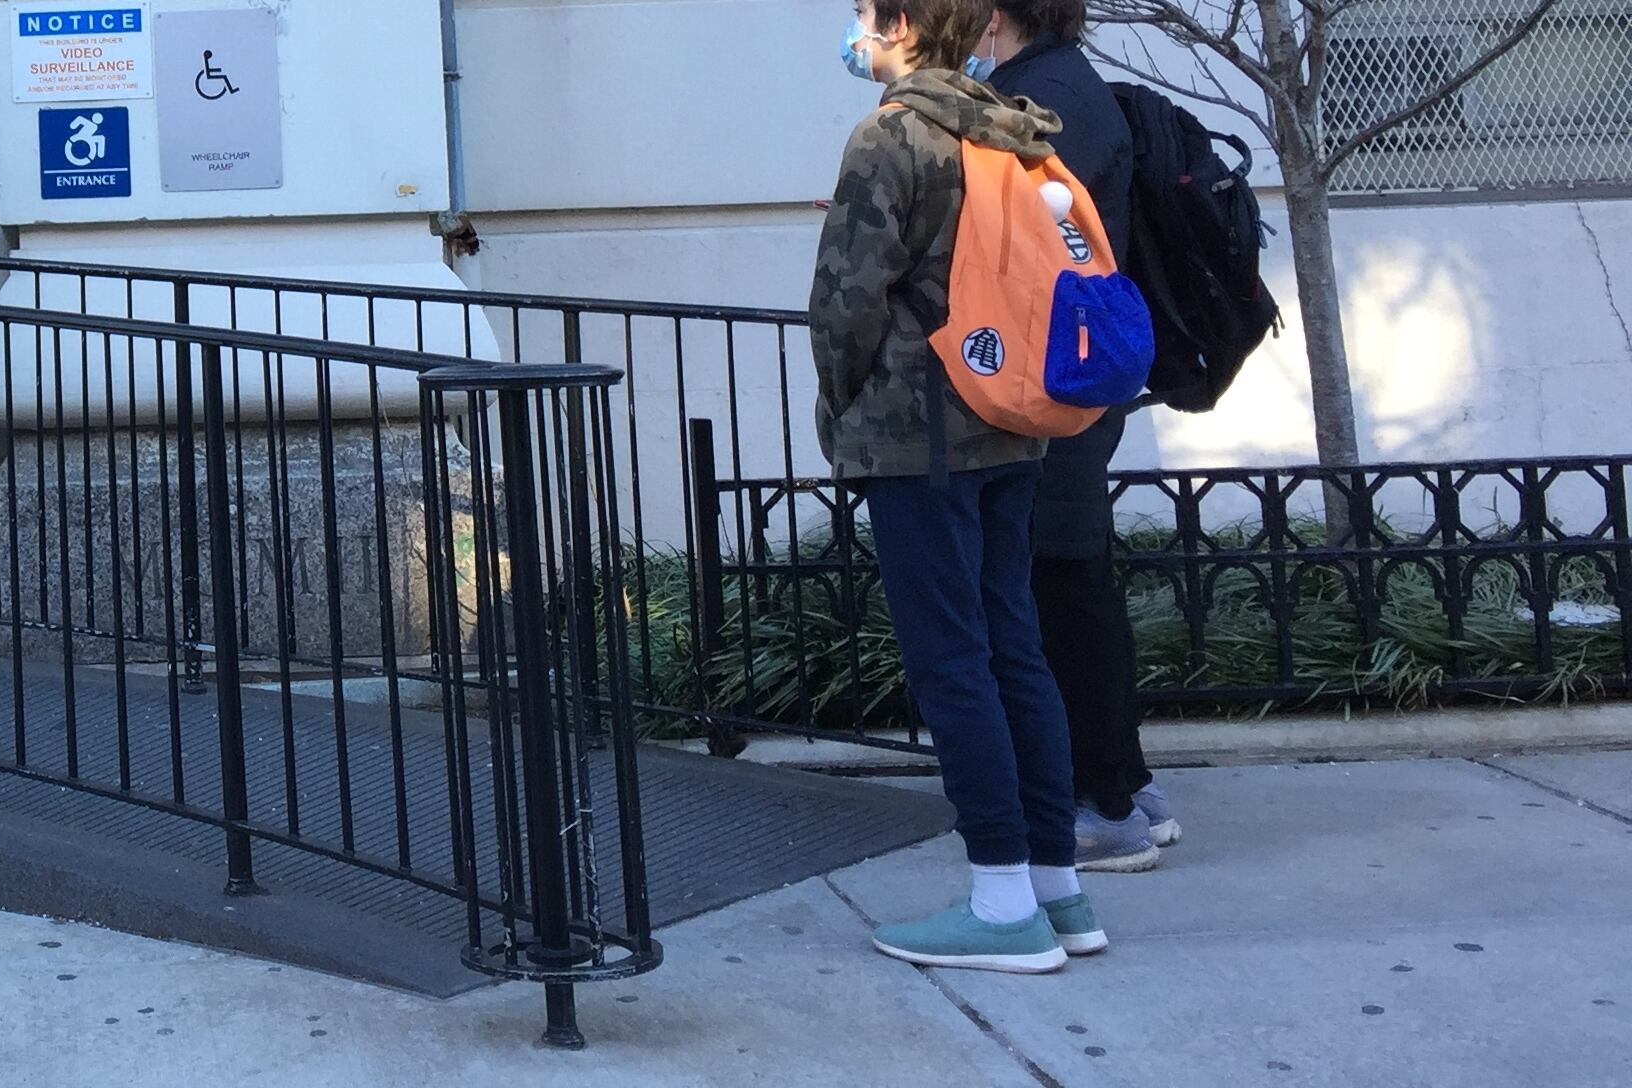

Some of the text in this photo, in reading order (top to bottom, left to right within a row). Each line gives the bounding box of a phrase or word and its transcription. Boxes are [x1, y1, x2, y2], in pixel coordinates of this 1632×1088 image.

[27, 12, 135, 32] NOTICE
[61, 47, 102, 59] VIDEO
[30, 60, 134, 74] SURVEILLANCE
[191, 151, 251, 162] WHEELCHAIR
[56, 174, 117, 187] ENTRANCE
